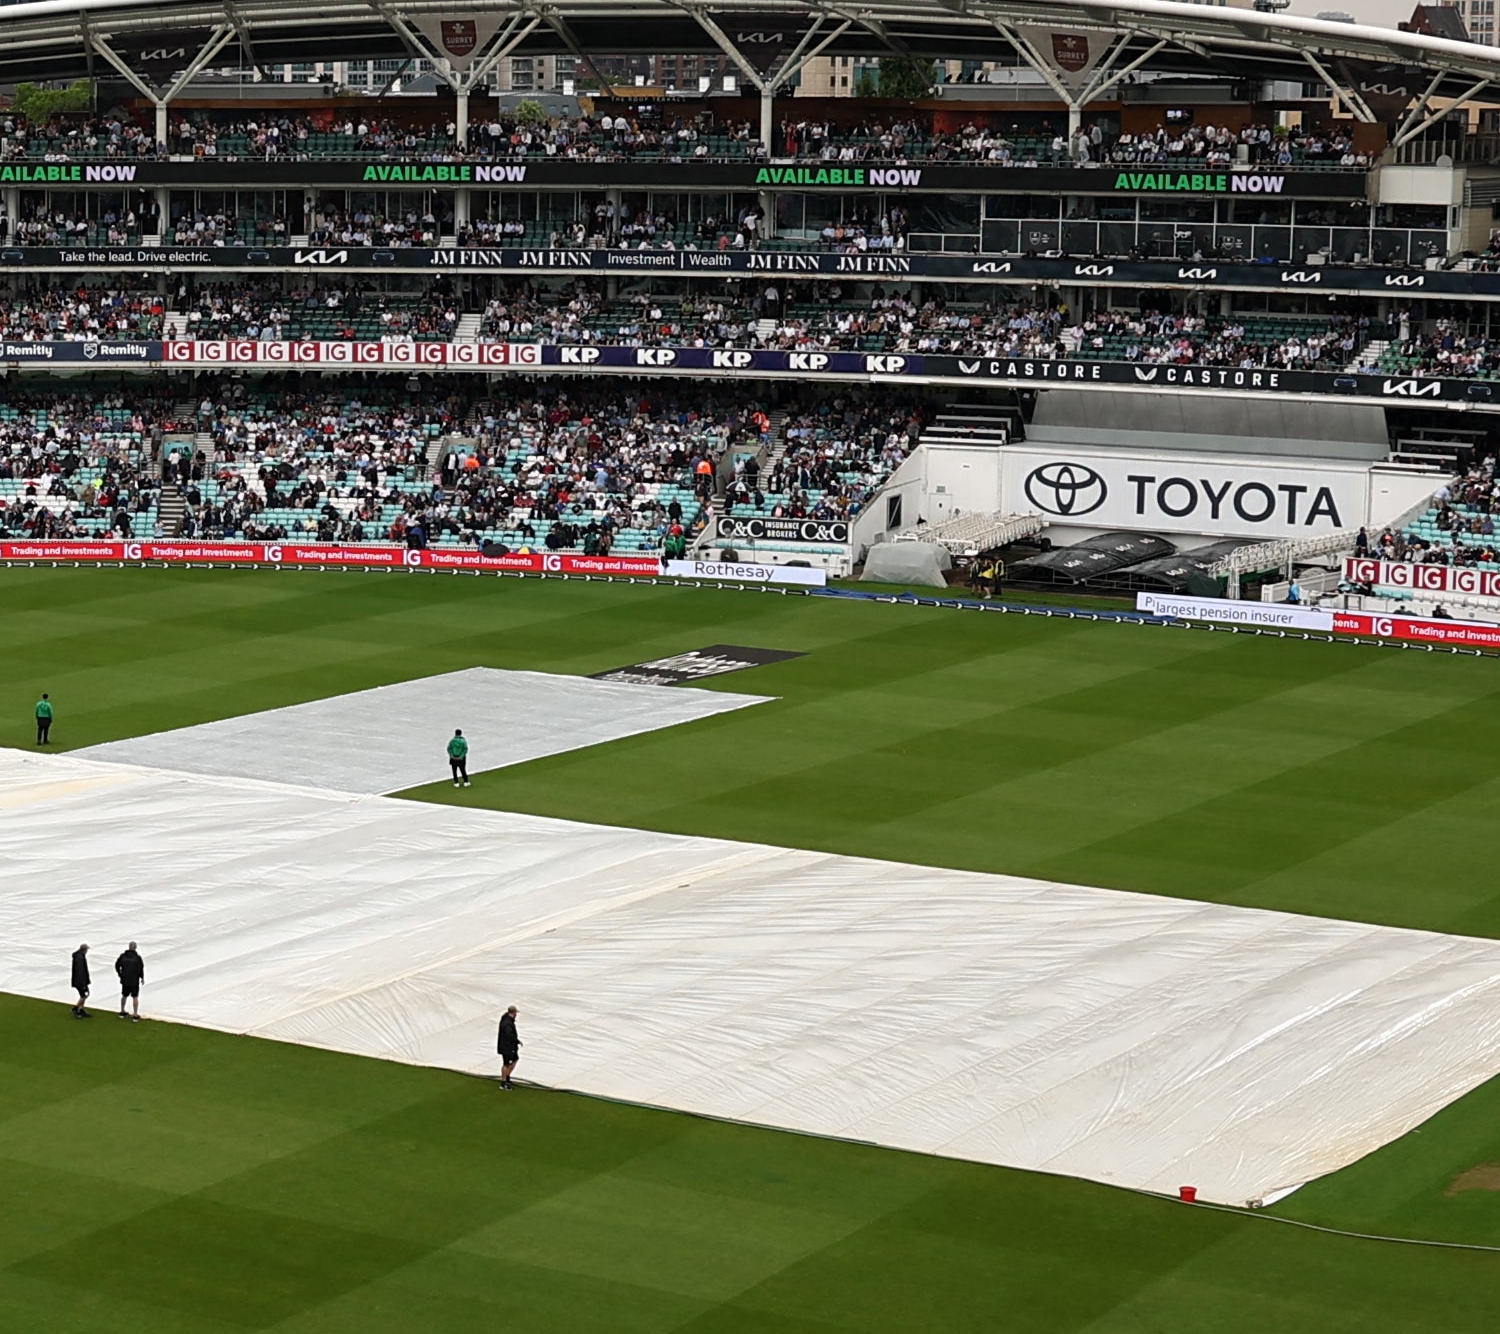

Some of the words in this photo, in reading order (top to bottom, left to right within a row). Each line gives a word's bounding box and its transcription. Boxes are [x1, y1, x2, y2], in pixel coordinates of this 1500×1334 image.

[86, 166, 136, 181] NOW
[363, 166, 470, 181] AVAILABLE
[475, 166, 527, 181] NOW
[755, 168, 864, 184] AVAILABLE
[869, 169, 922, 185] NOW
[1115, 173, 1226, 192] AVAILABLE
[1231, 175, 1284, 193] NOW
[59, 251, 85, 262] Take
[87, 251, 105, 262] the
[108, 251, 135, 262] lead.
[137, 251, 166, 262] Drive
[168, 251, 211, 262] electric.
[430, 251, 454, 265] JM
[460, 251, 503, 264] FINN
[608, 253, 675, 266] Investment
[689, 254, 731, 267] Wealth
[6, 345, 53, 358] Remitly
[168, 342, 190, 358] IG
[231, 343, 253, 359] IG
[294, 343, 316, 360] IG
[357, 344, 379, 360] IG
[560, 347, 599, 363] KP
[637, 349, 676, 366] KP
[712, 350, 752, 367] KP
[990, 362, 1100, 379] CASTORE
[1167, 368, 1279, 387] CASTORE
[1127, 475, 1342, 527] TOYOTA
[718, 519, 764, 538] C&C
[765, 521, 799, 530] INSURANCE
[767, 529, 797, 539] BROKERS
[801, 522, 847, 541] C&C
[695, 562, 774, 581] Rothesay
[1352, 561, 1376, 581] IG
[1155, 600, 1197, 621] largest
[1199, 606, 1248, 625] pension
[1250, 611, 1294, 625] insurer
[1371, 617, 1393, 636] IG
[1409, 625, 1445, 638] Trading
[1447, 629, 1466, 638] and
